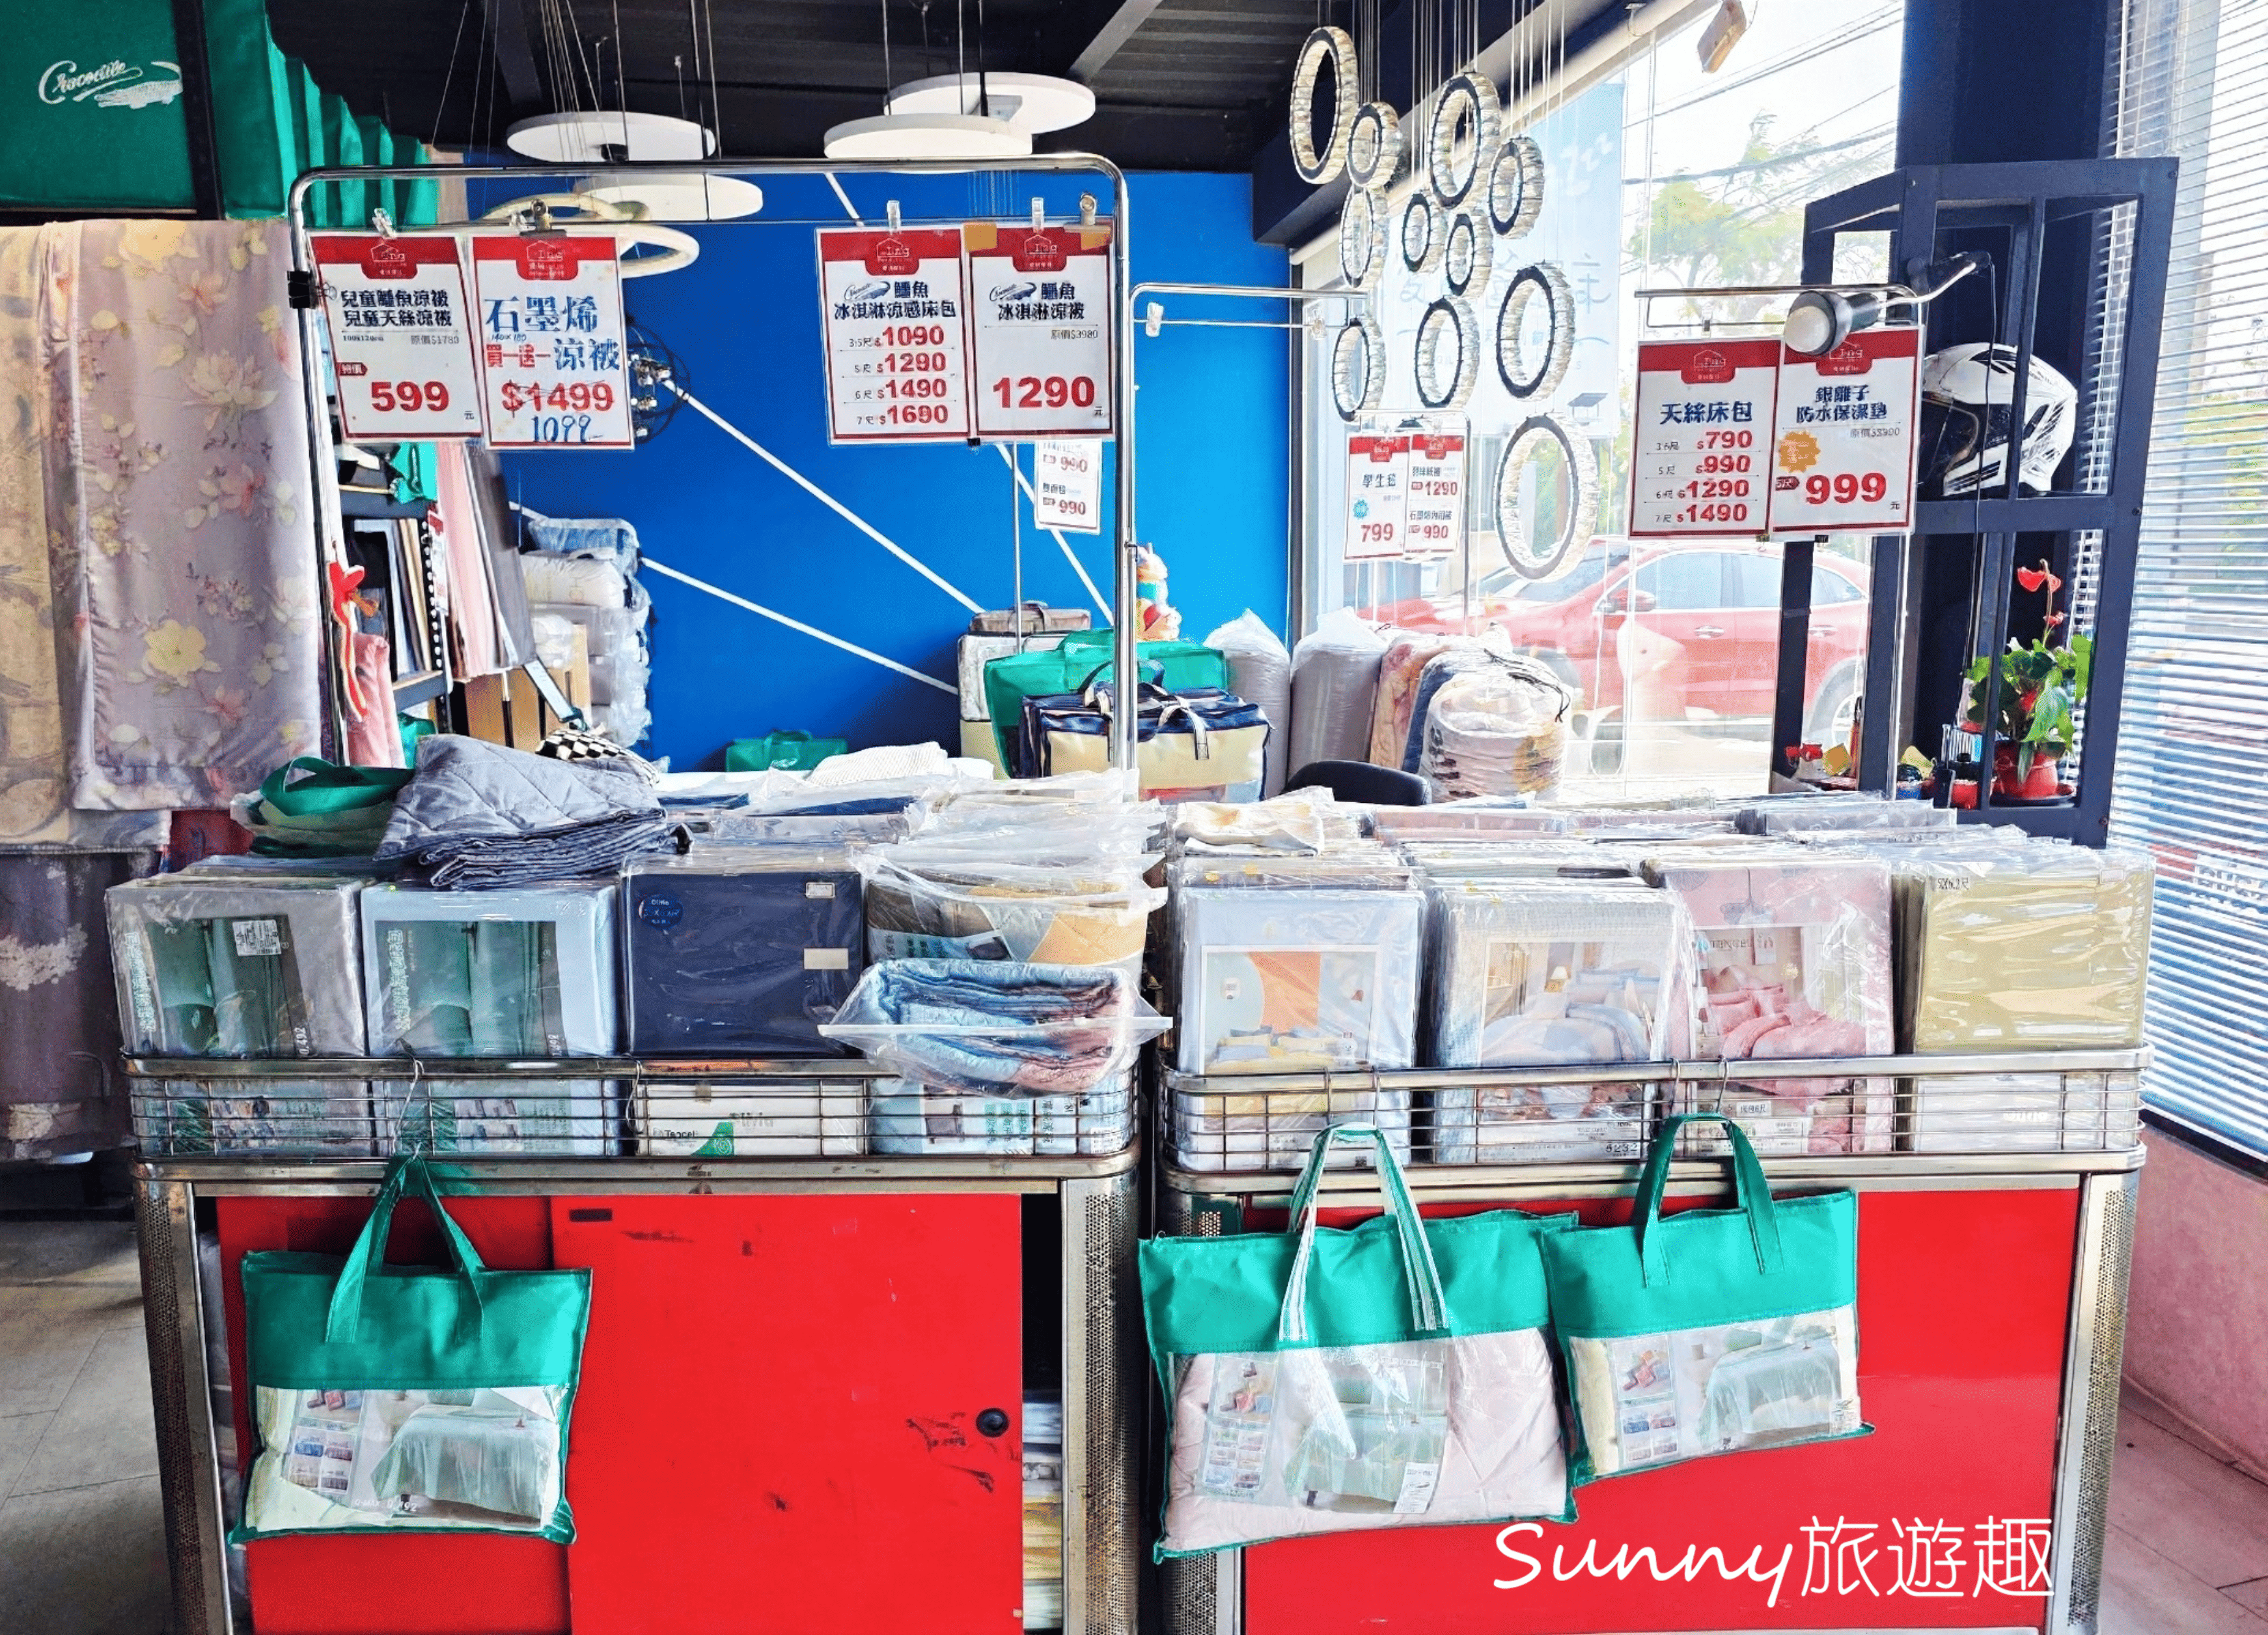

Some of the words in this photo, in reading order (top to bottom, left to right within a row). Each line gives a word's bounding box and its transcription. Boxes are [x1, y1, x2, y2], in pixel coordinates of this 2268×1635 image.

[344, 310, 452, 327] 兒童天絲涼被
[484, 296, 598, 333] 石墨烯
[834, 300, 956, 320] 冰淇淋涼感床包
[998, 302, 1085, 320] 冰淇淋涼被
[486, 344, 551, 367] 買一送一
[554, 337, 620, 370] 涼被
[371, 381, 449, 412] 599
[993, 376, 1095, 408] 1290
[1815, 385, 1870, 403] 銀離子
[1660, 400, 1753, 425] 天絲床包
[1796, 402, 1887, 423] 防水保潔墊
[531, 415, 591, 442] 1099
[1425, 481, 1458, 496] 1290
[1806, 473, 1887, 505] 999
[1059, 499, 1086, 515] 990
[1361, 523, 1394, 542] 799
[1424, 525, 1448, 539] 990
